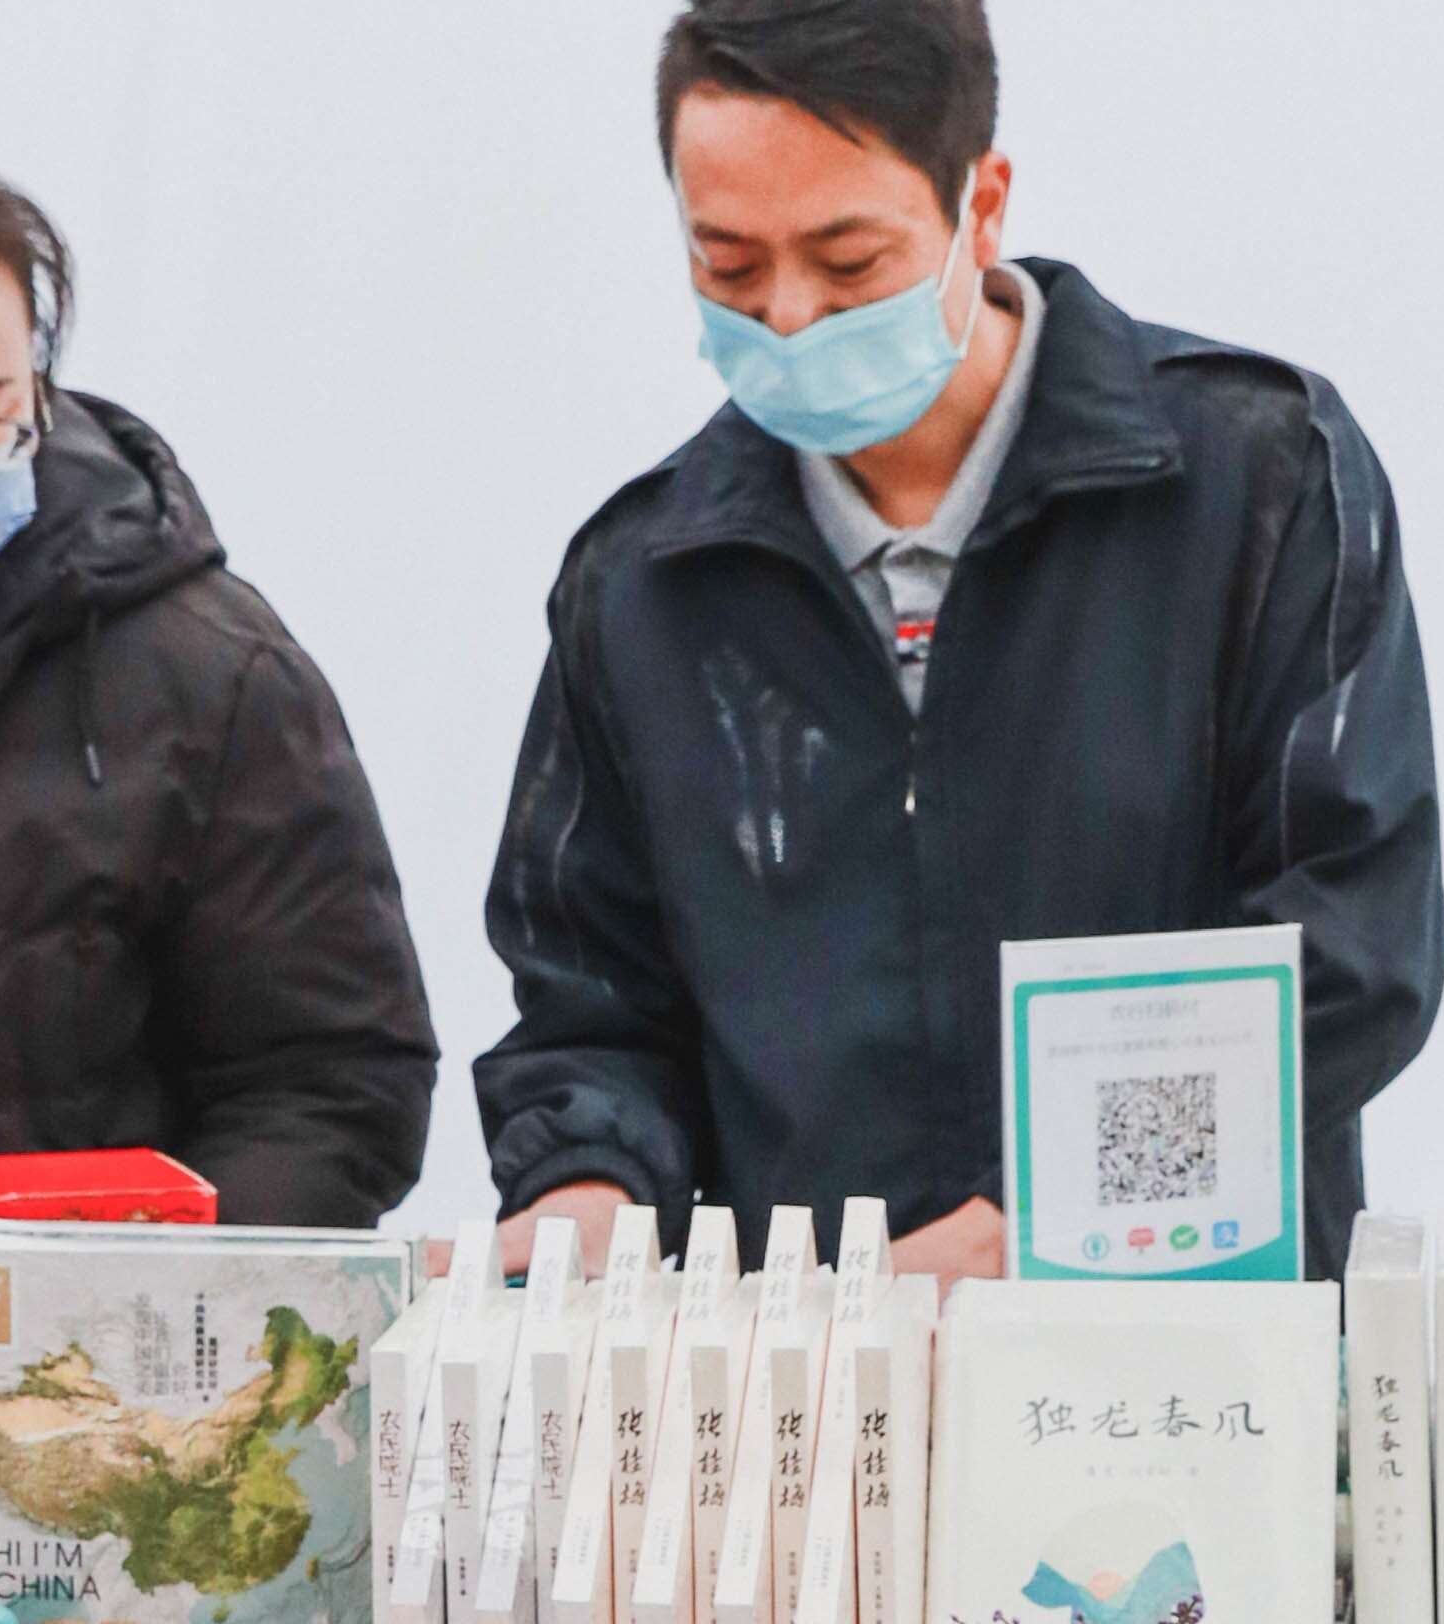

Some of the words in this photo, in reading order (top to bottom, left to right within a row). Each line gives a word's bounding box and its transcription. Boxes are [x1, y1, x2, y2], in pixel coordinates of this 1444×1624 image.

[617, 1406, 646, 1509] 张桂梅
[697, 1407, 725, 1507] 张桂梅
[777, 1407, 806, 1509] 张桂梅
[862, 1407, 890, 1509] 张桂梅
[1017, 1395, 1266, 1441] 独龙春风
[33, 1542, 83, 1569] I'M
